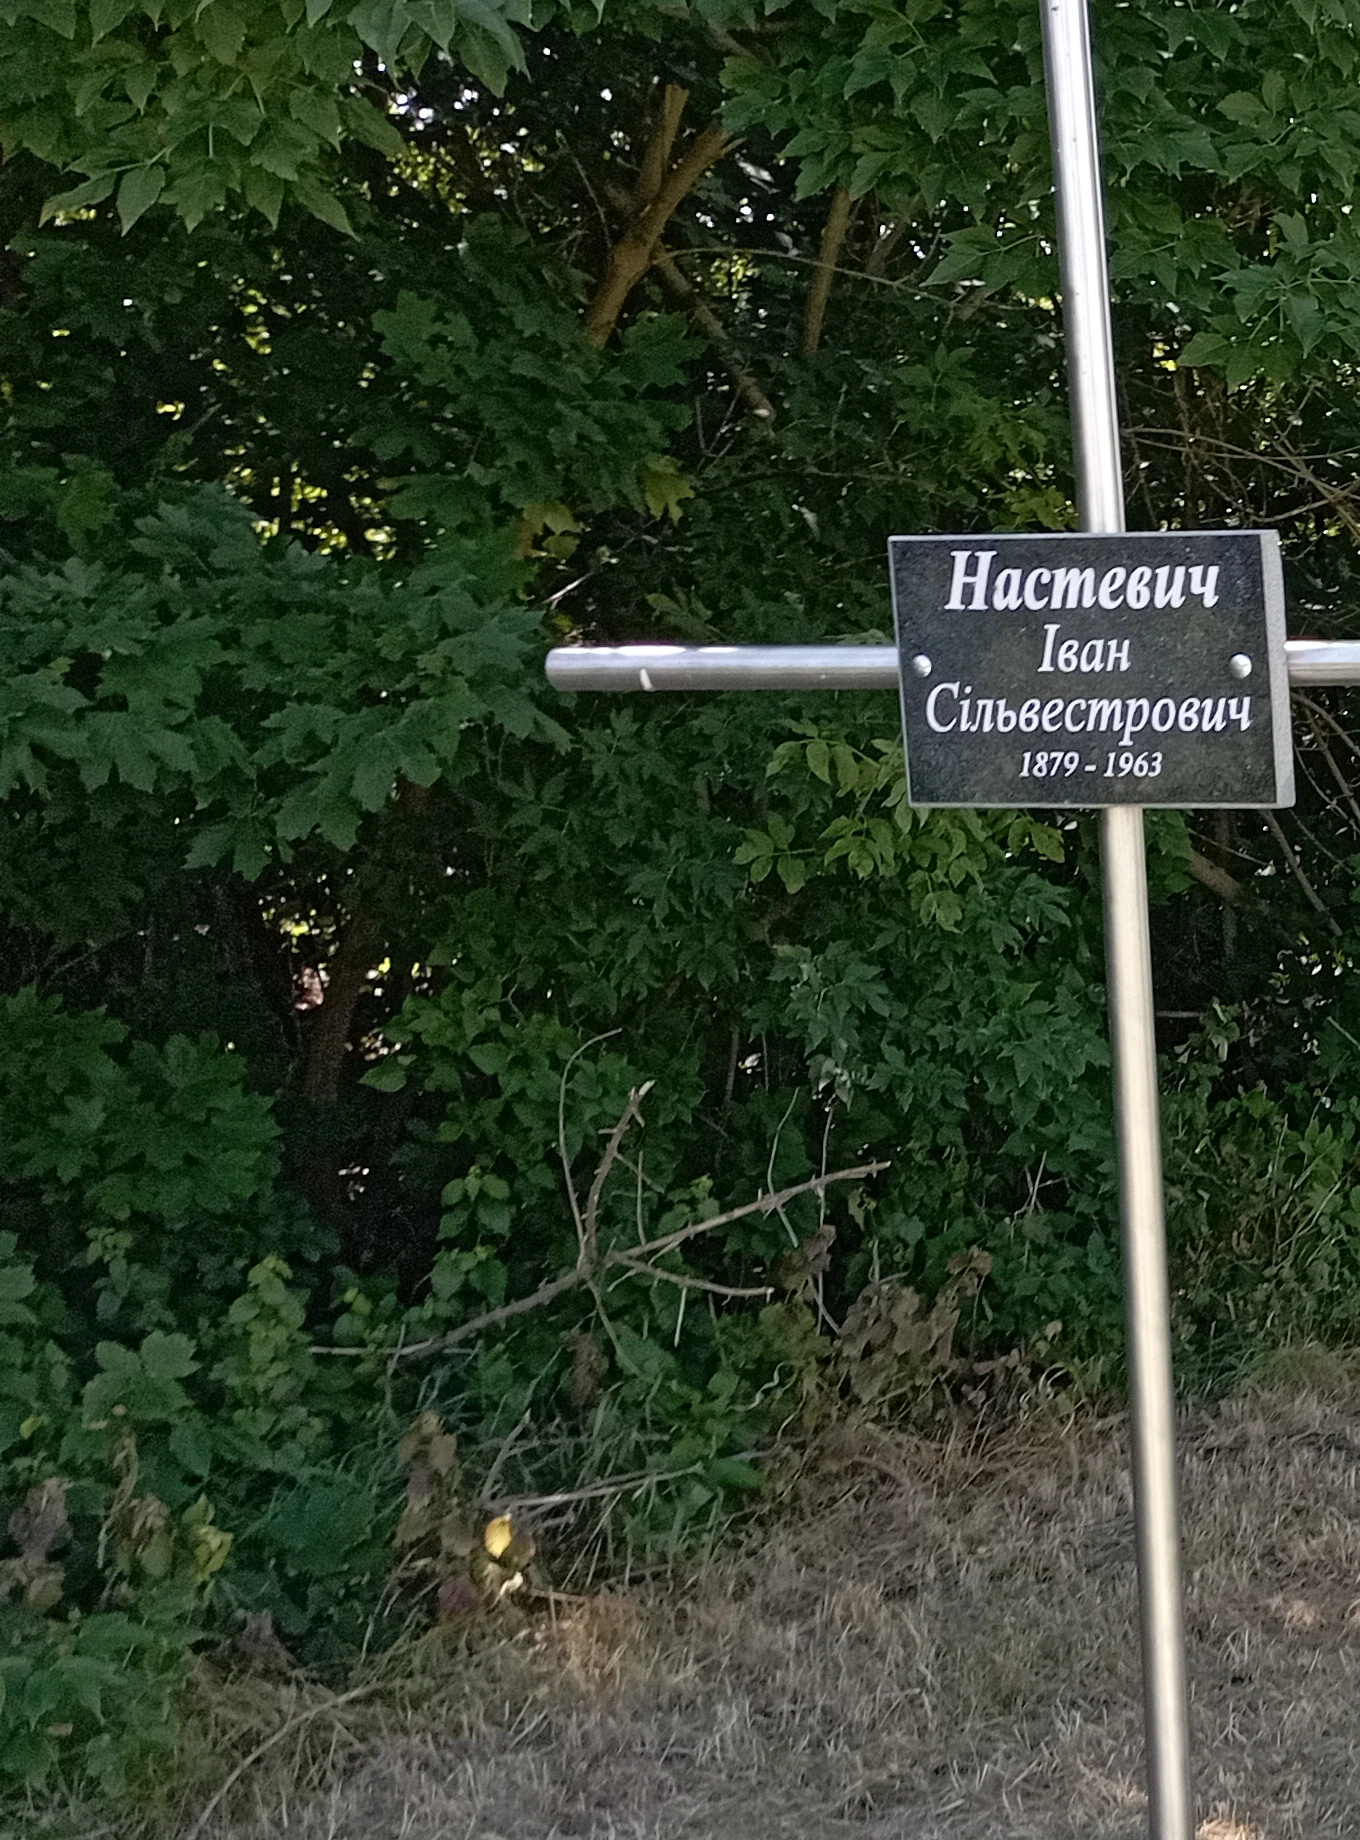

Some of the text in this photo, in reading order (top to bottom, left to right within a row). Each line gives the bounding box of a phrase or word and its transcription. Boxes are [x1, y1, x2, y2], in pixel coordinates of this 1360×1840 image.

[944, 550, 1220, 611] Настевич
[1037, 624, 1131, 673] Іван
[925, 681, 1252, 747] Сільвестрович
[1018, 751, 1080, 778] 1879
[1103, 751, 1163, 778] 1963
